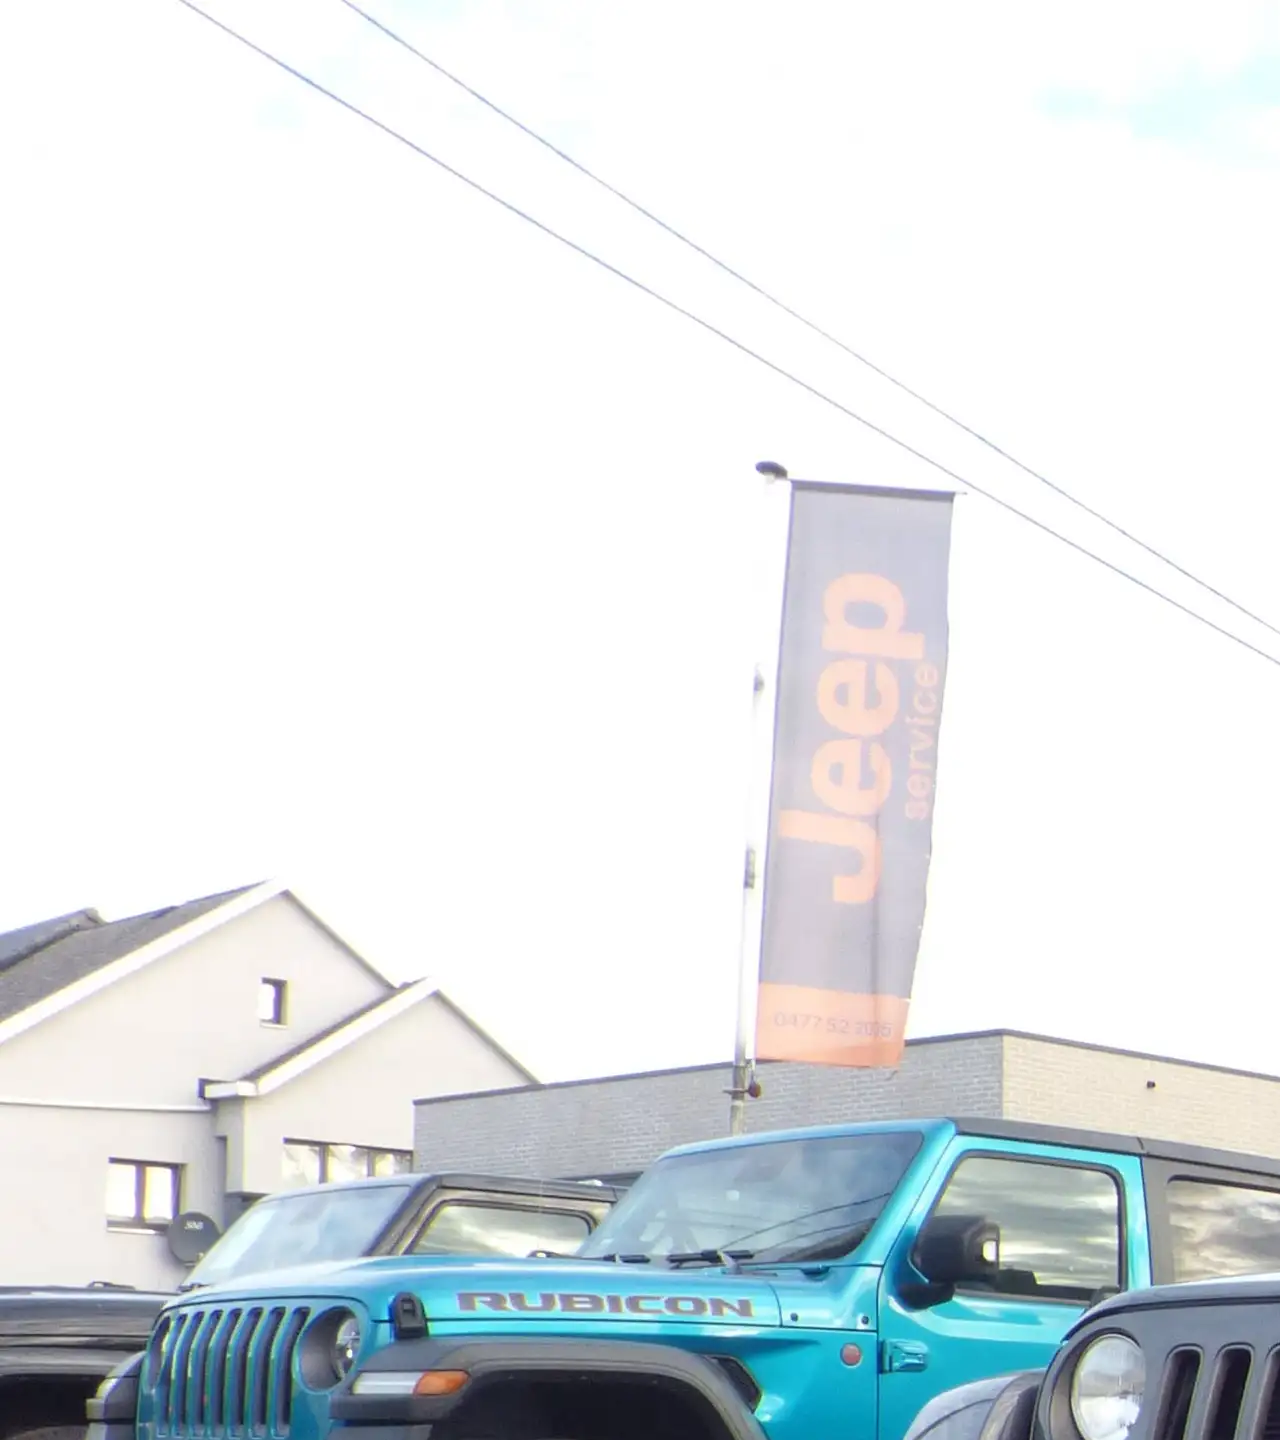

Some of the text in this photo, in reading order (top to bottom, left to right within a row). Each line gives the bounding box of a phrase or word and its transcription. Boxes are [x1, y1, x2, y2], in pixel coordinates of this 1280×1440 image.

[777, 572, 925, 904] Jeep
[905, 660, 939, 821] service
[456, 1292, 756, 1317] RUBICON
